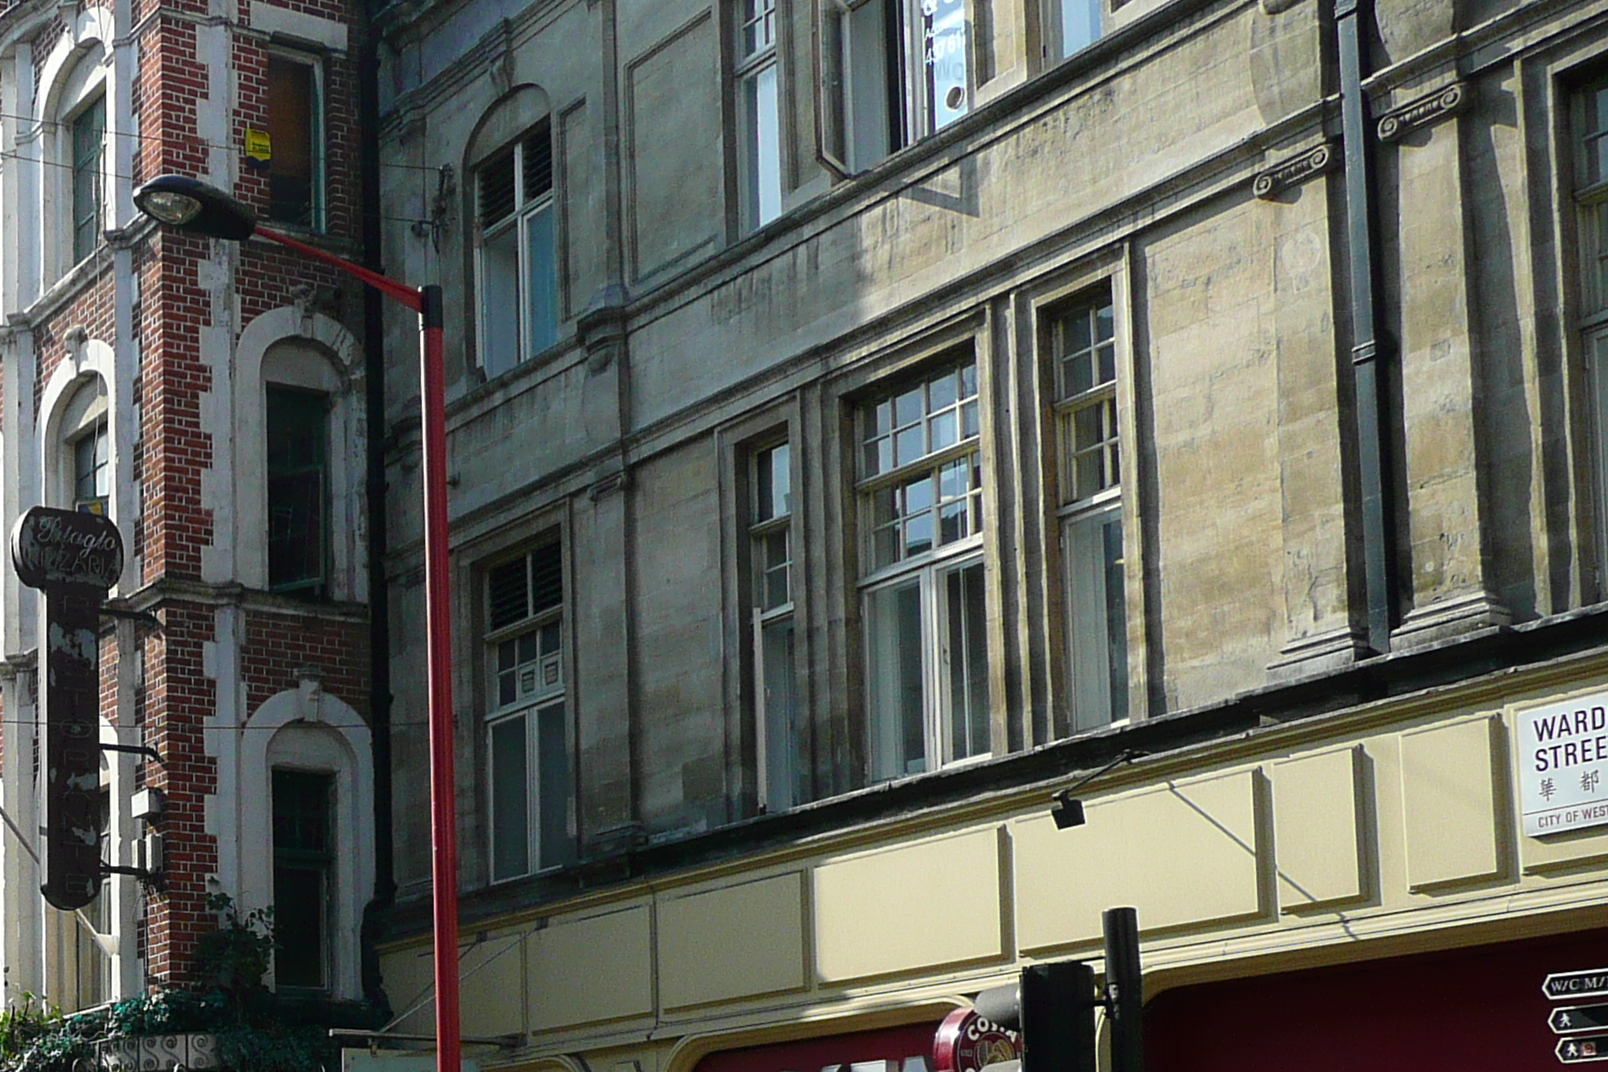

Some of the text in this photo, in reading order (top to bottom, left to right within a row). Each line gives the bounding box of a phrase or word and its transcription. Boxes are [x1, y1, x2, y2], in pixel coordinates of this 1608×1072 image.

[1535, 735, 1608, 772] STREE
[1538, 815, 1562, 828] CITY
[1565, 810, 1579, 823] OF
[1584, 975, 1608, 989] M/
